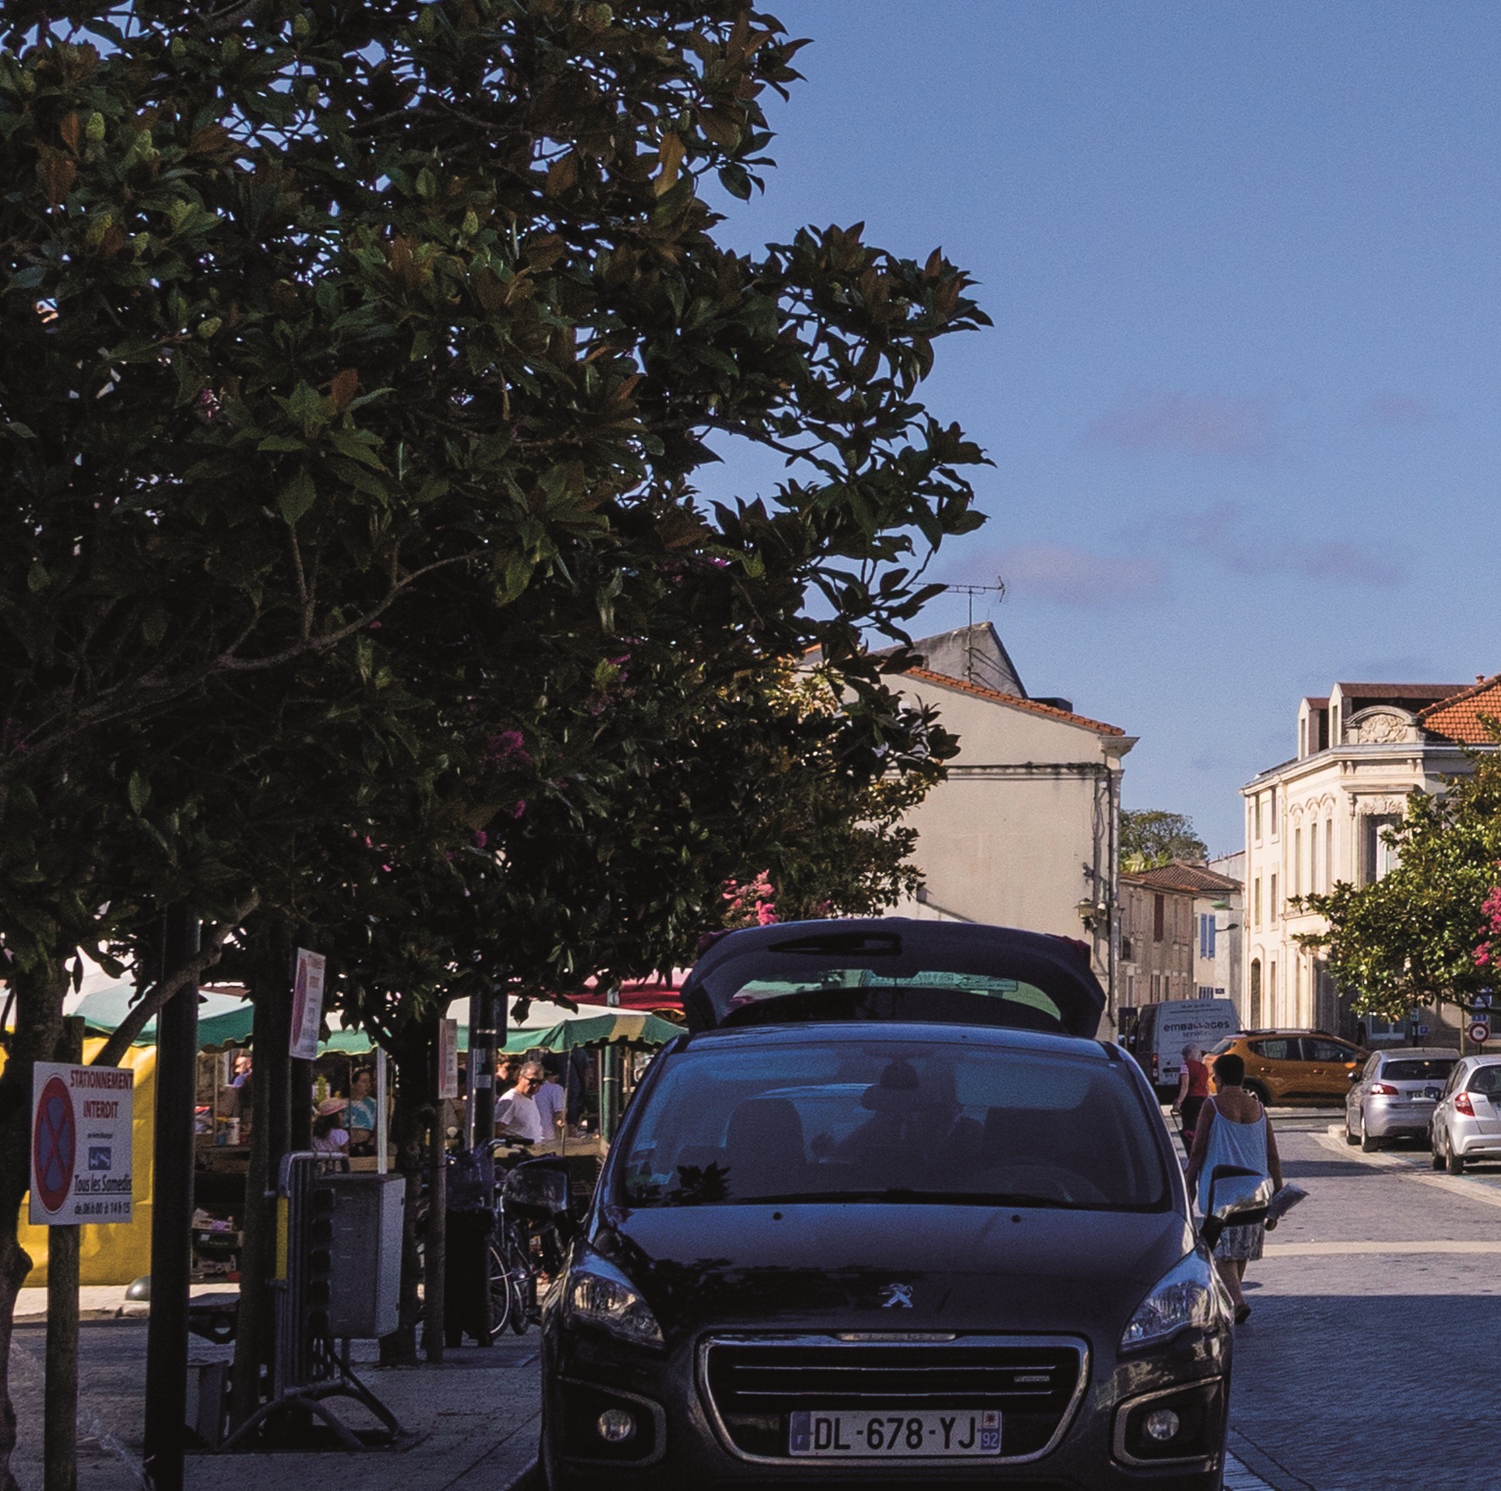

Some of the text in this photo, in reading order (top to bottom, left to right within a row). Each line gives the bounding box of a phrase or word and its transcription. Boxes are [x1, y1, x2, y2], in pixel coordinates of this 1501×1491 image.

[70, 1070, 134, 1090] STATIONNEMENT
[83, 1100, 119, 1119] INTERDIT
[74, 1173, 133, 1192] Tous les Samedis
[813, 1416, 977, 1451] DL-678-YJ
[982, 1432, 998, 1447] 92
